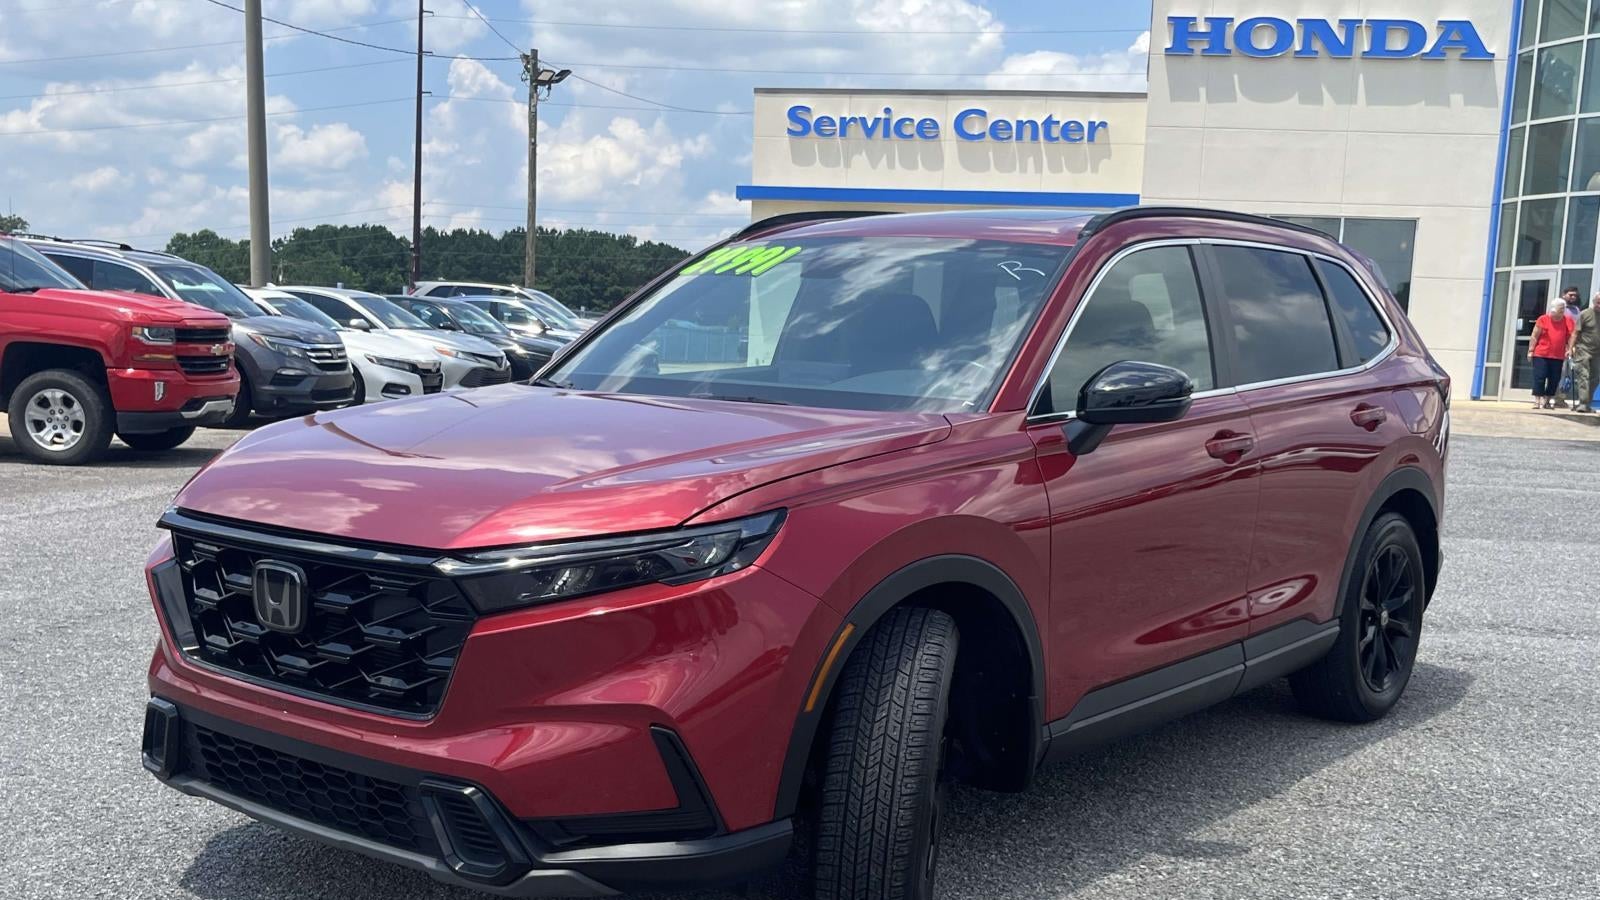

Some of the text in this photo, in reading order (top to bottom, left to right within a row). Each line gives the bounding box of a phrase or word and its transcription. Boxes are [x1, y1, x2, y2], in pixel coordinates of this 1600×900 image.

[1164, 16, 1496, 60] HONDA
[786, 105, 1109, 144] Service Center
